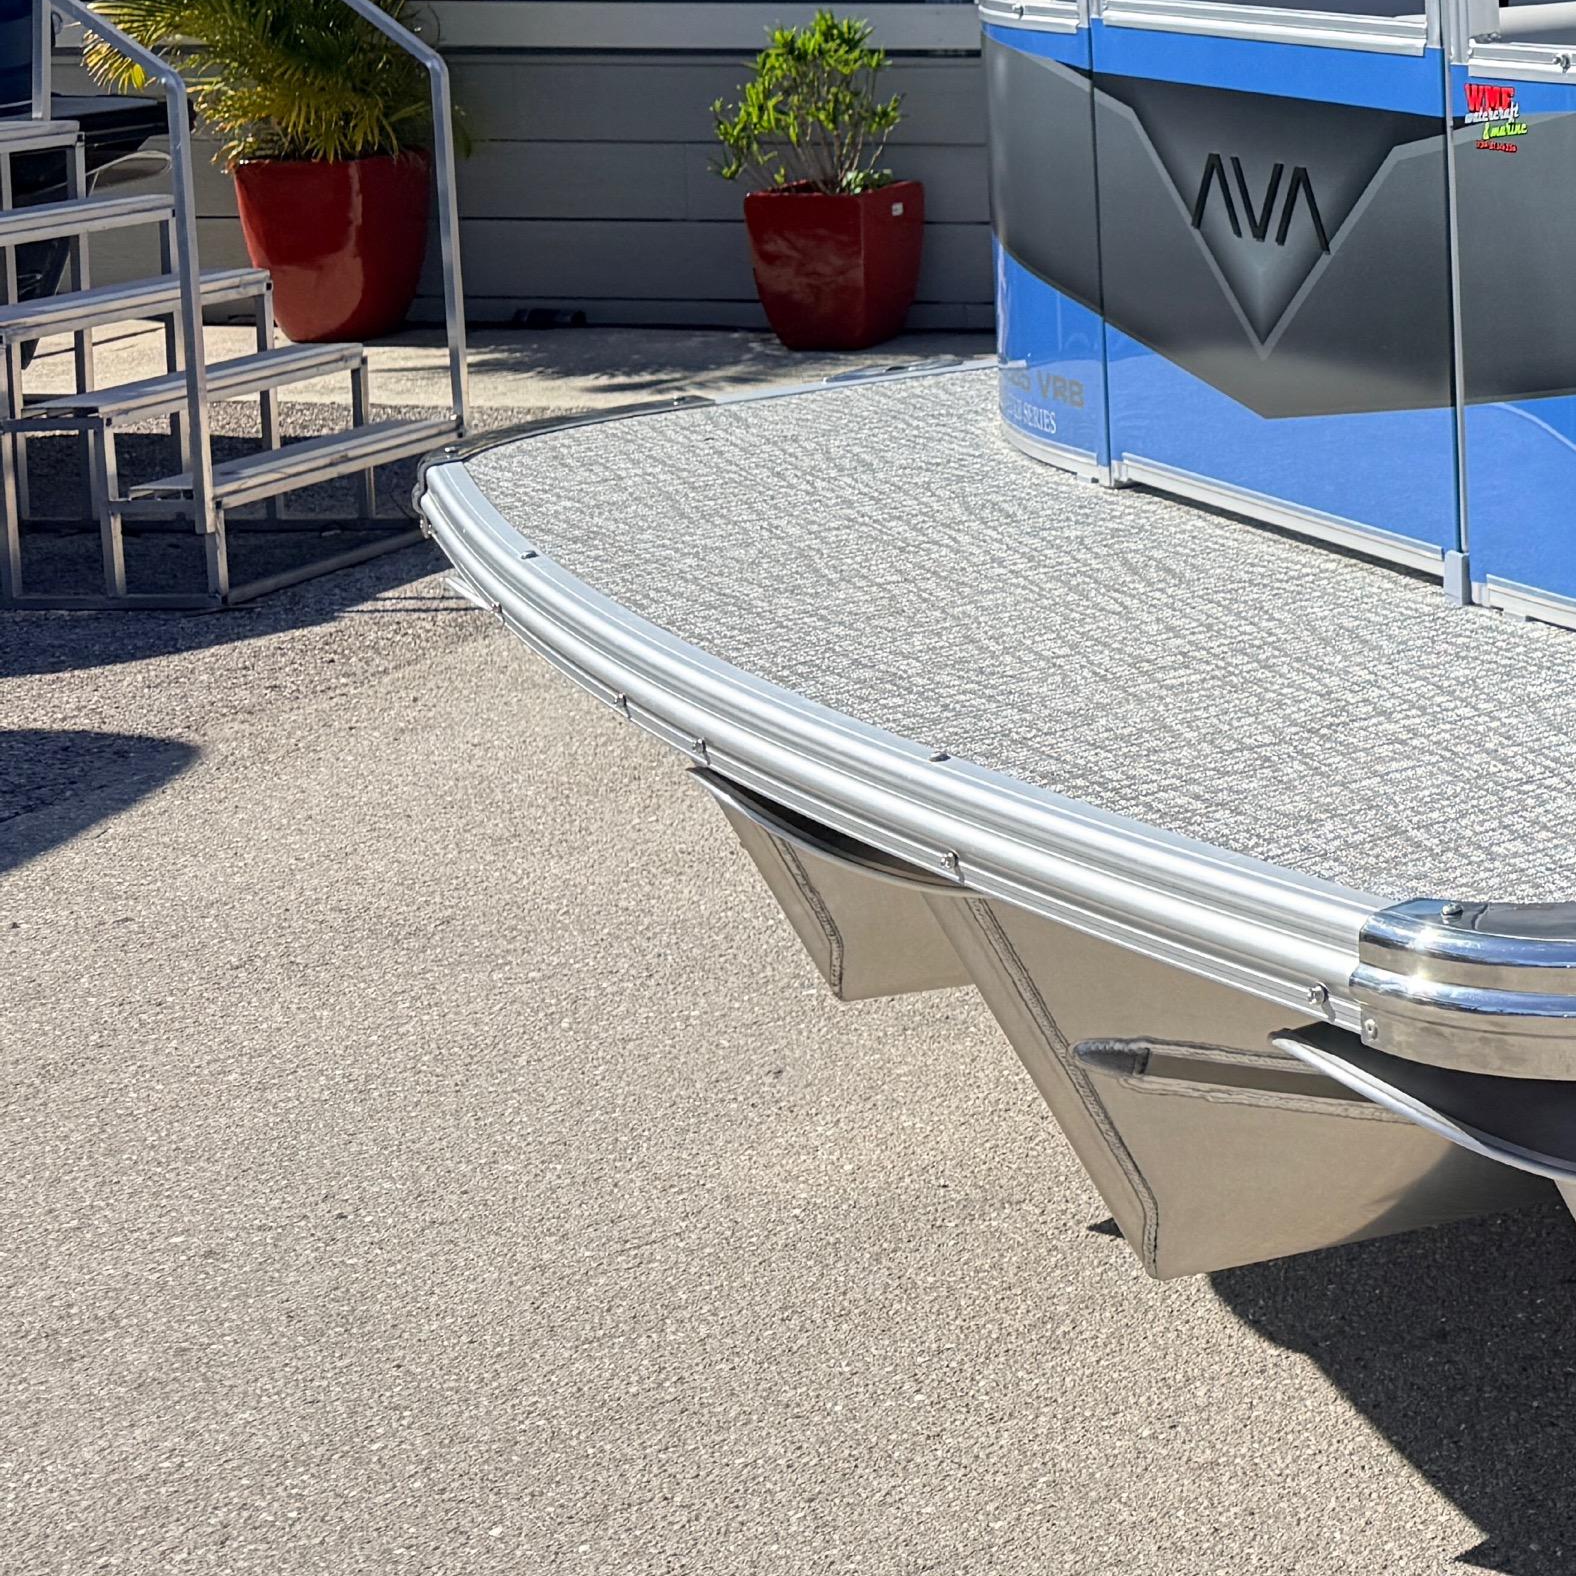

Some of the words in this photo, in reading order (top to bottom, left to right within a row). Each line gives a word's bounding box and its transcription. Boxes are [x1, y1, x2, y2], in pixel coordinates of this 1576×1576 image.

[1464, 84, 1515, 112] WMF
[1191, 153, 1331, 254] AVA
[1024, 402, 1057, 434] SERIES
